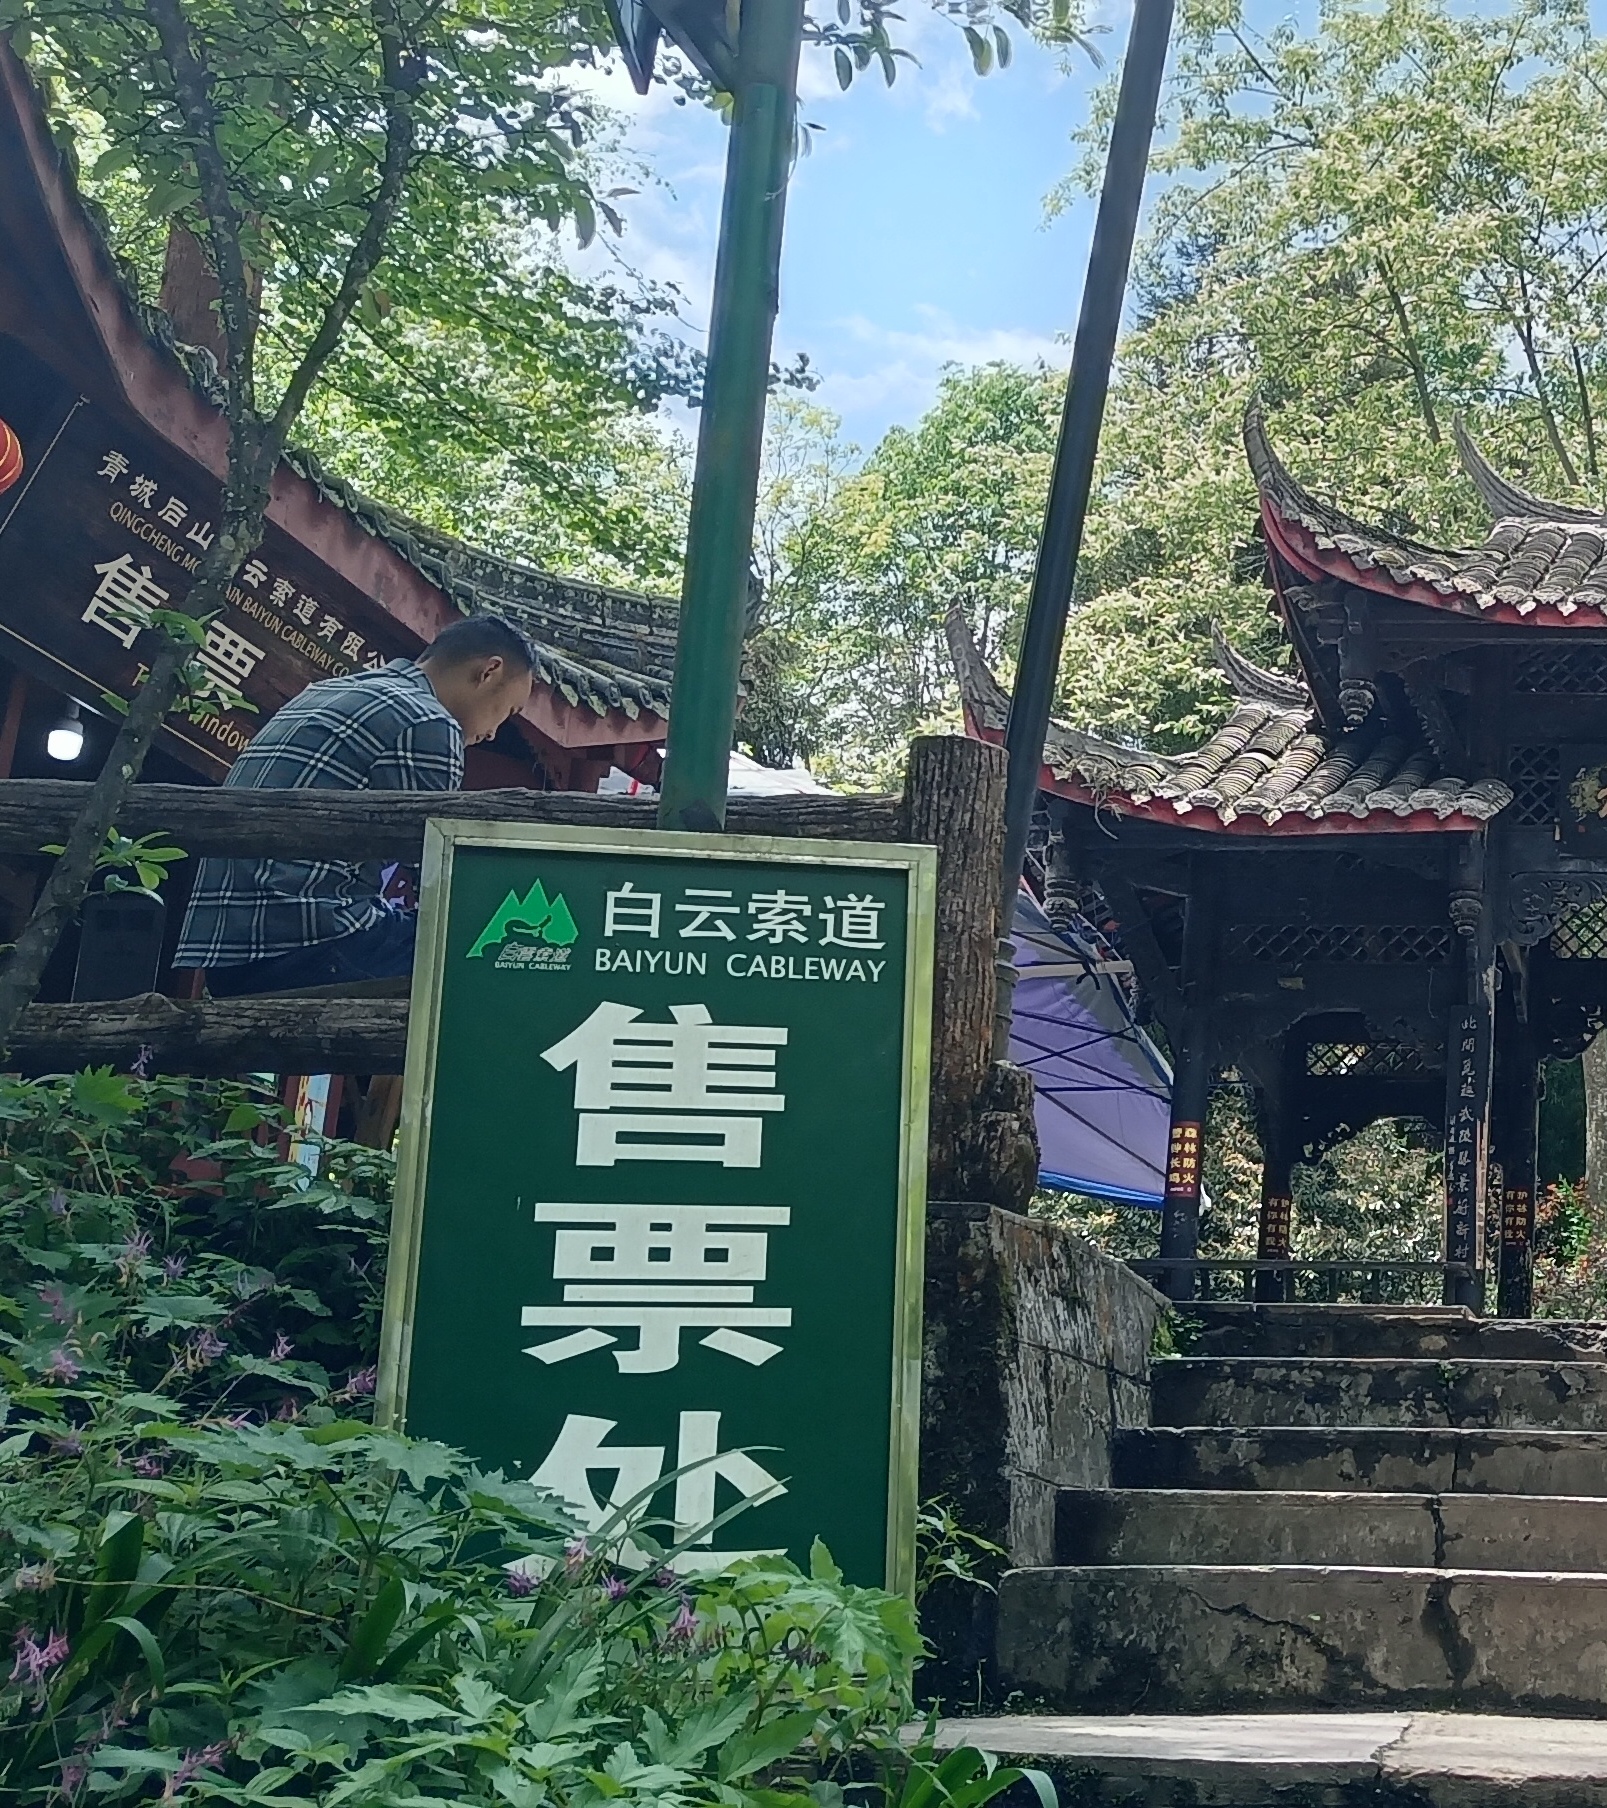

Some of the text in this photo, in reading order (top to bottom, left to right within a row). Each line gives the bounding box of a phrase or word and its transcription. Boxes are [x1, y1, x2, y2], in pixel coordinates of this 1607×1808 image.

[97, 450, 386, 674] 青城后山云索道有限公
[109, 501, 185, 562] QINGCHENG
[241, 597, 284, 635] BAIYUN
[280, 625, 336, 675] CABLEWAY
[81, 553, 266, 711] 售票
[494, 961, 572, 971] BAIYUN CABLEWAY
[594, 948, 887, 983] BAIYUN CABLEWAY
[603, 881, 887, 951] 白云索道
[1182, 1127, 1198, 1184] 森林防火
[502, 1001, 793, 1580] 售票处
